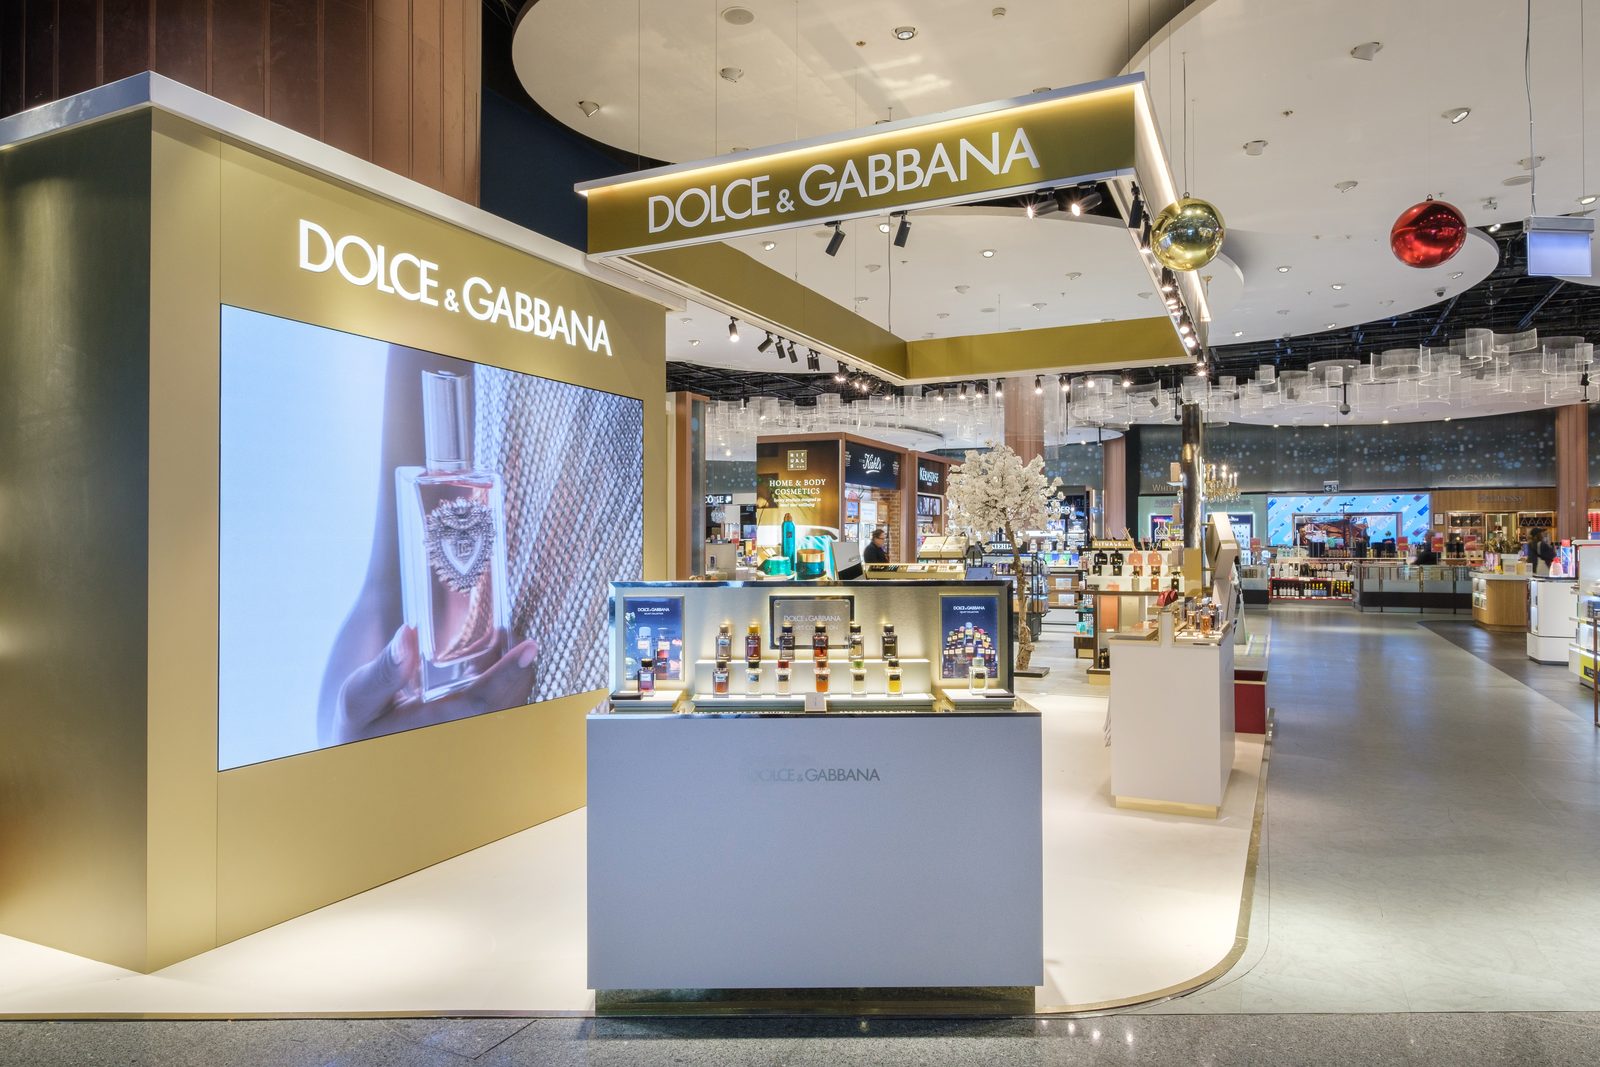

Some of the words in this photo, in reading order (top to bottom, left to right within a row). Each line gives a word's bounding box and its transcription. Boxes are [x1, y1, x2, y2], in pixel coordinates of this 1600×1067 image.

[648, 175, 770, 233] DOLCE
[776, 188, 795, 213] &
[799, 128, 1041, 206] GABBANA
[299, 219, 439, 306] DOLCE
[444, 288, 460, 313] &
[462, 276, 613, 357] GABBANA
[774, 488, 821, 496] COSMETICS
[804, 768, 880, 782] GABBANA
